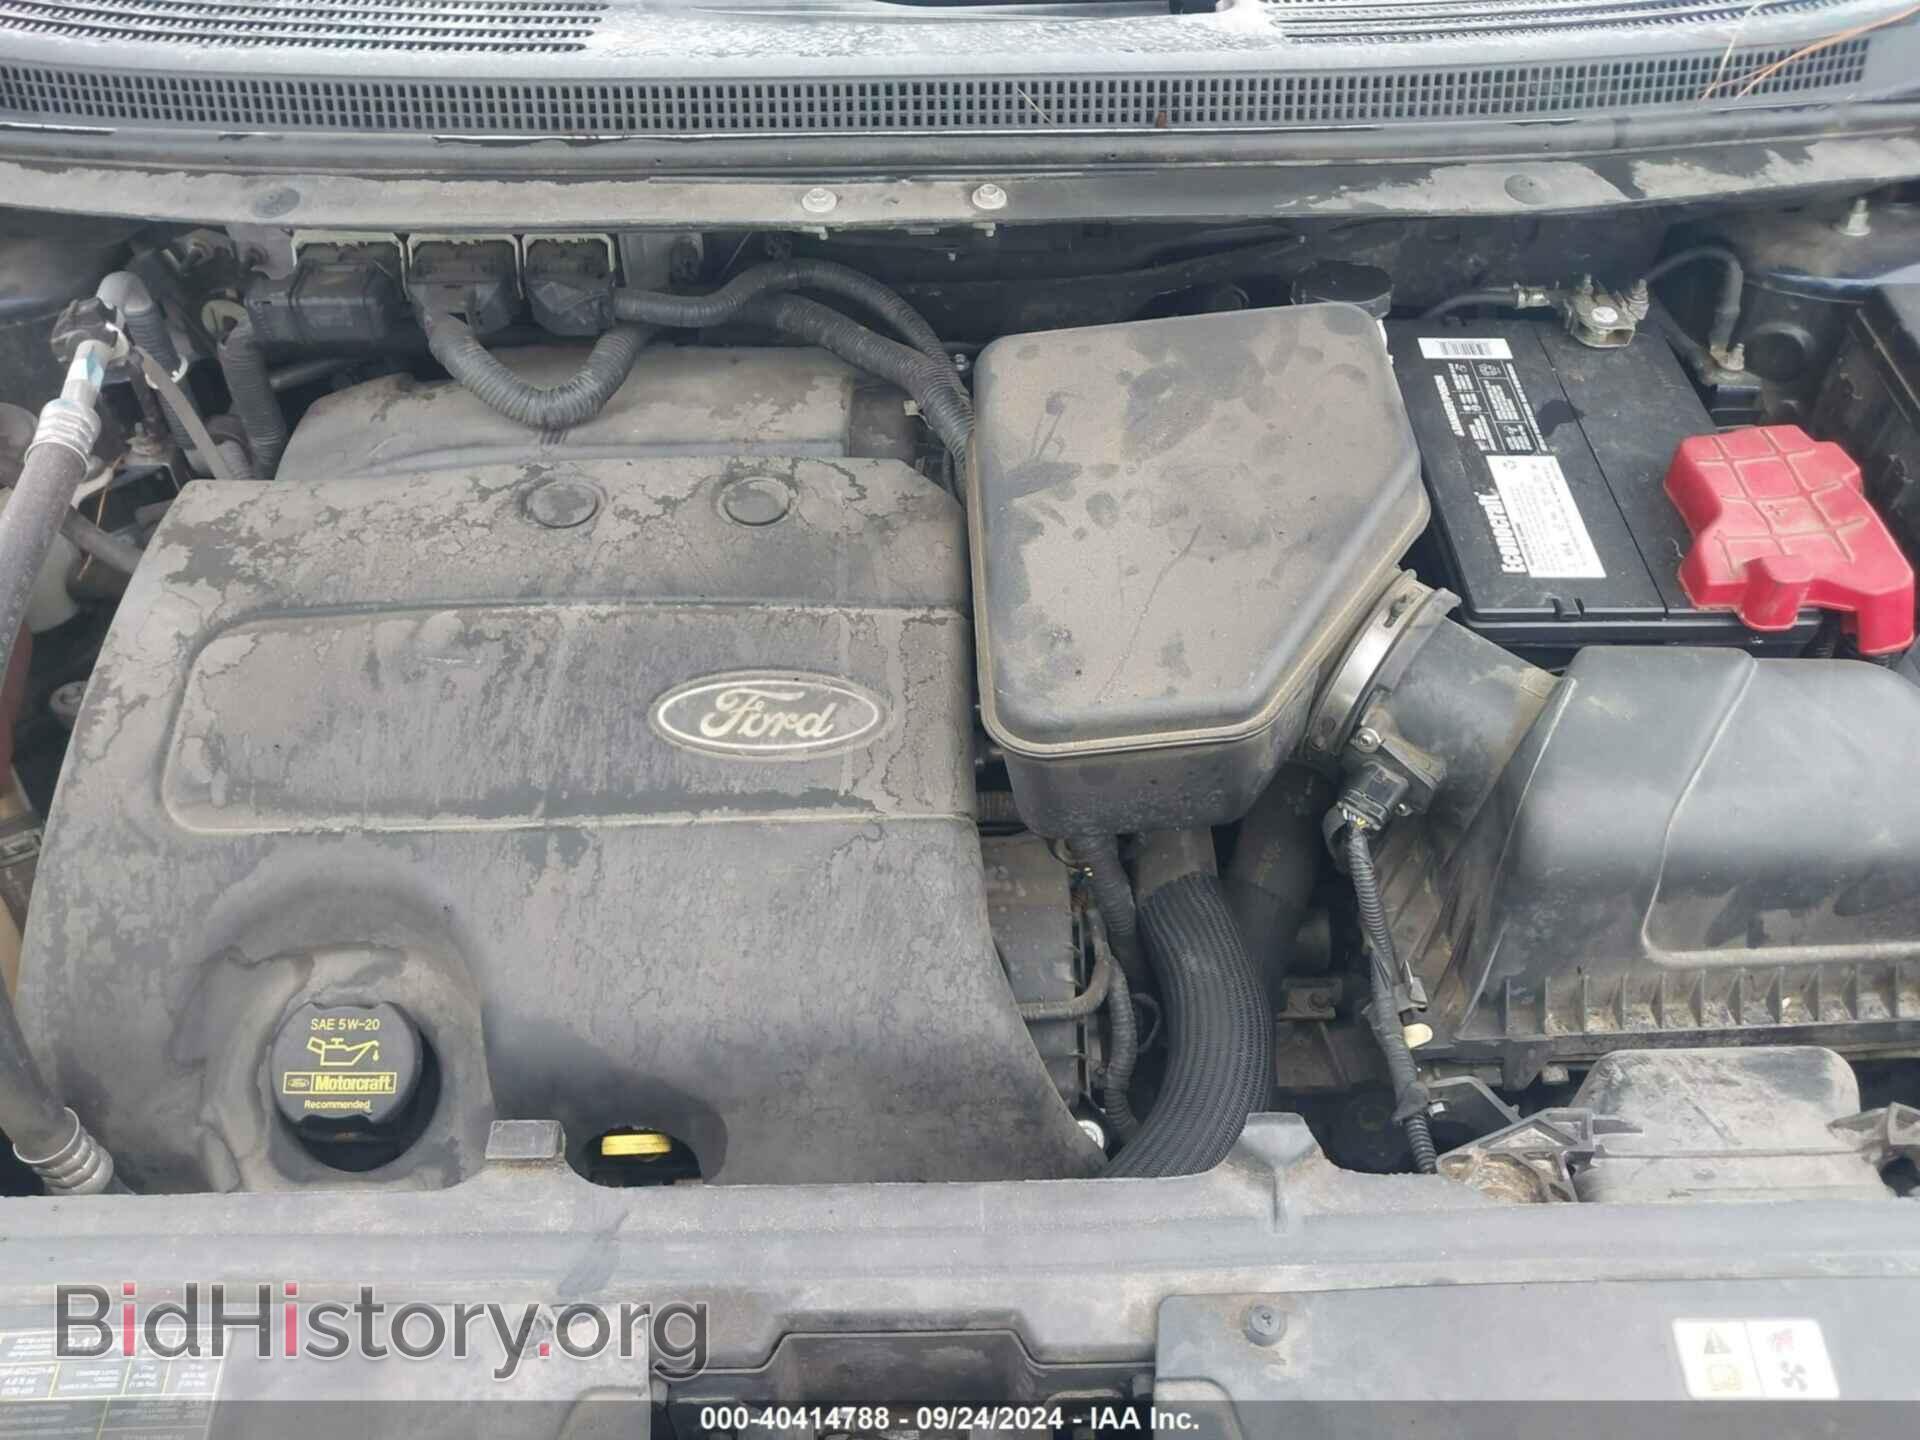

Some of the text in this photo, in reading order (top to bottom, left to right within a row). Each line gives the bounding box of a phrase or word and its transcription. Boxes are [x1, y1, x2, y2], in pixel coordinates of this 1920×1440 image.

[700, 688, 837, 737] Ford
[311, 1018, 380, 1031] SAE 5W-20
[315, 1075, 391, 1091] Motorcraft
[304, 1099, 369, 1110] Recommended
